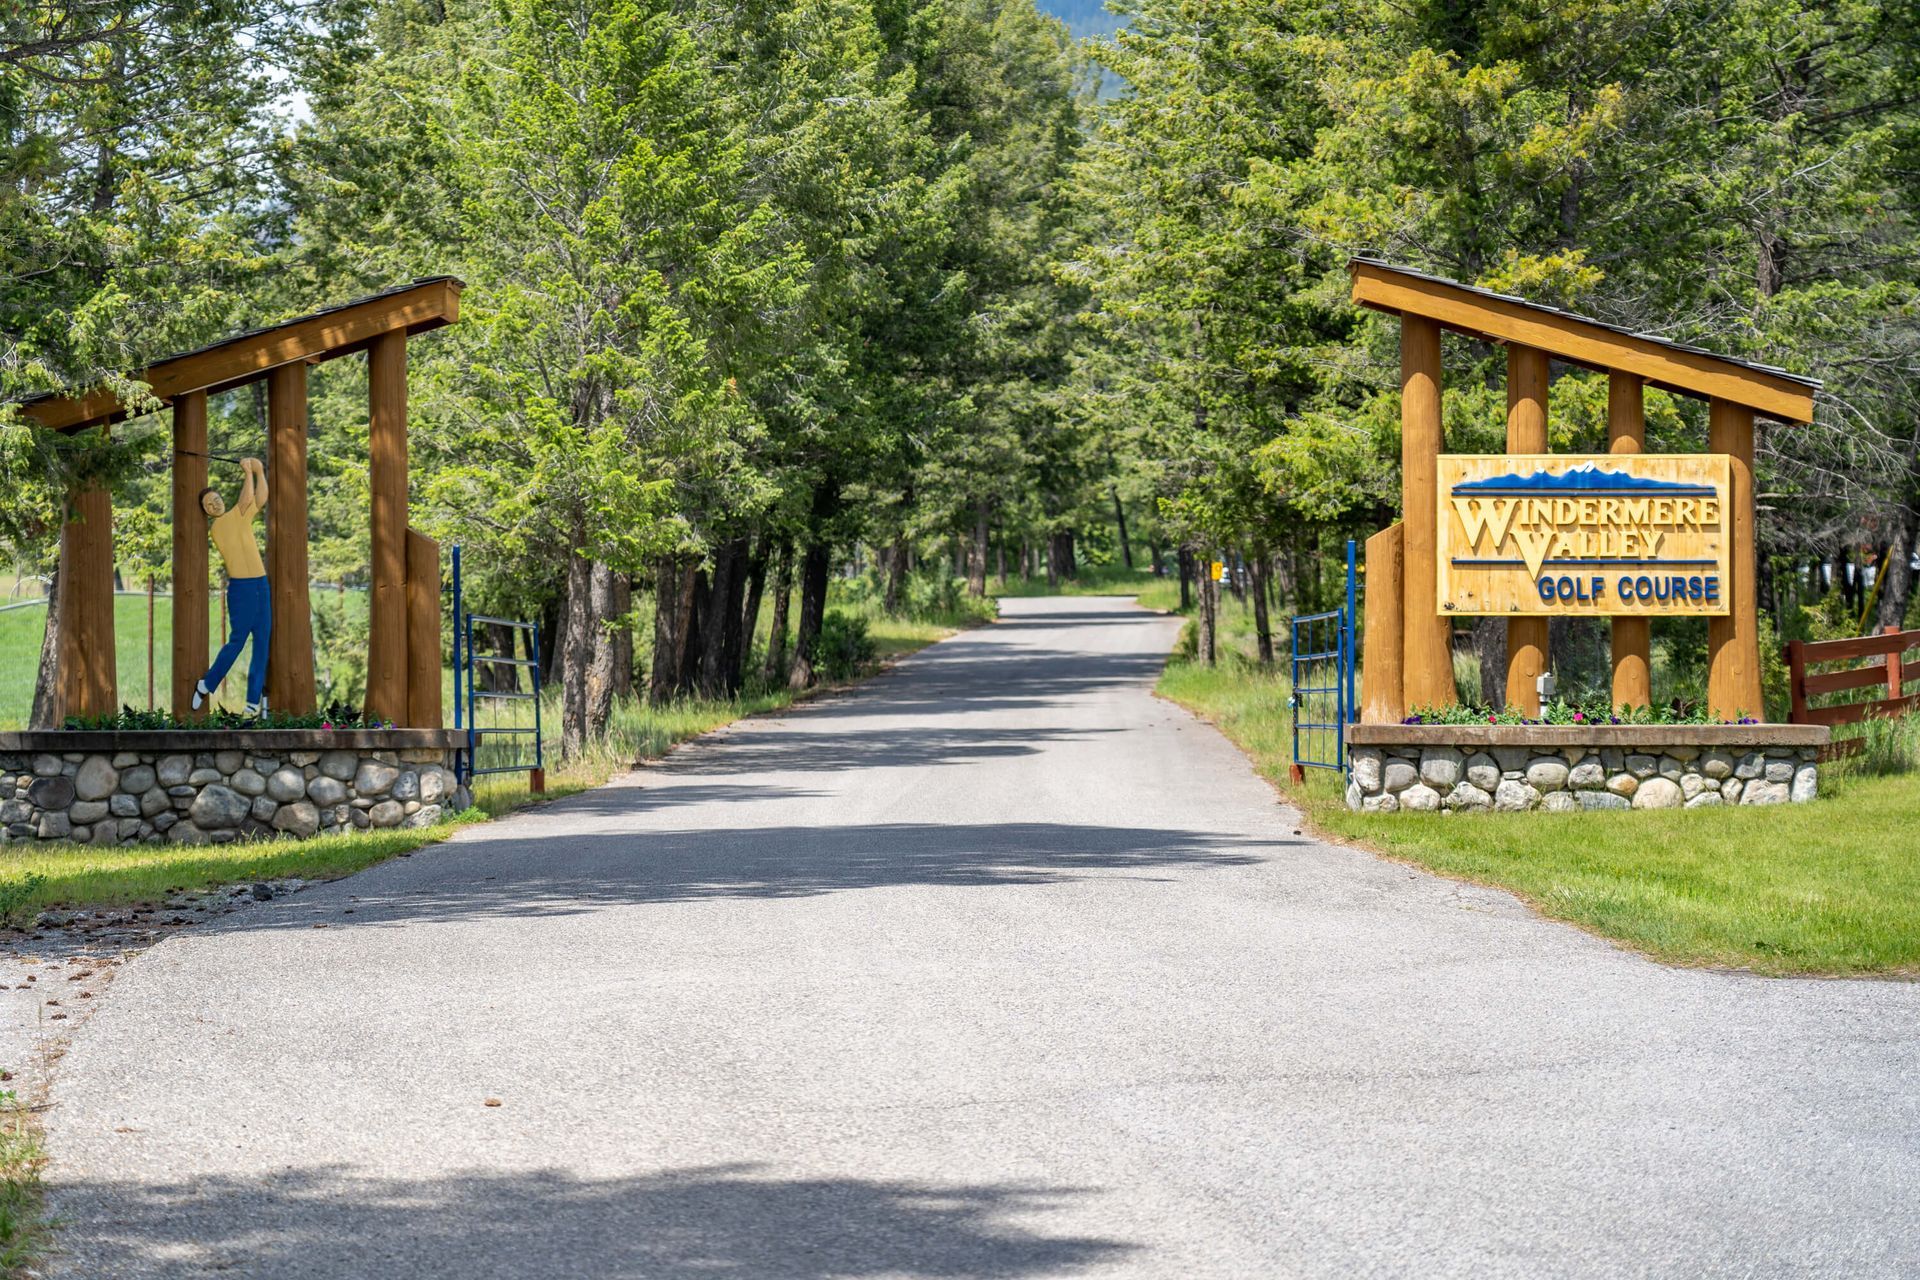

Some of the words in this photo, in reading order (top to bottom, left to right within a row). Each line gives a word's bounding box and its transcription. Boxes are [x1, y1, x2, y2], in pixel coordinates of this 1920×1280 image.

[1451, 498, 1719, 548] WINDERMERE
[1510, 531, 1664, 582] VALLEY
[1538, 576, 1604, 600] GOLF
[1618, 576, 1719, 600] COURSE
